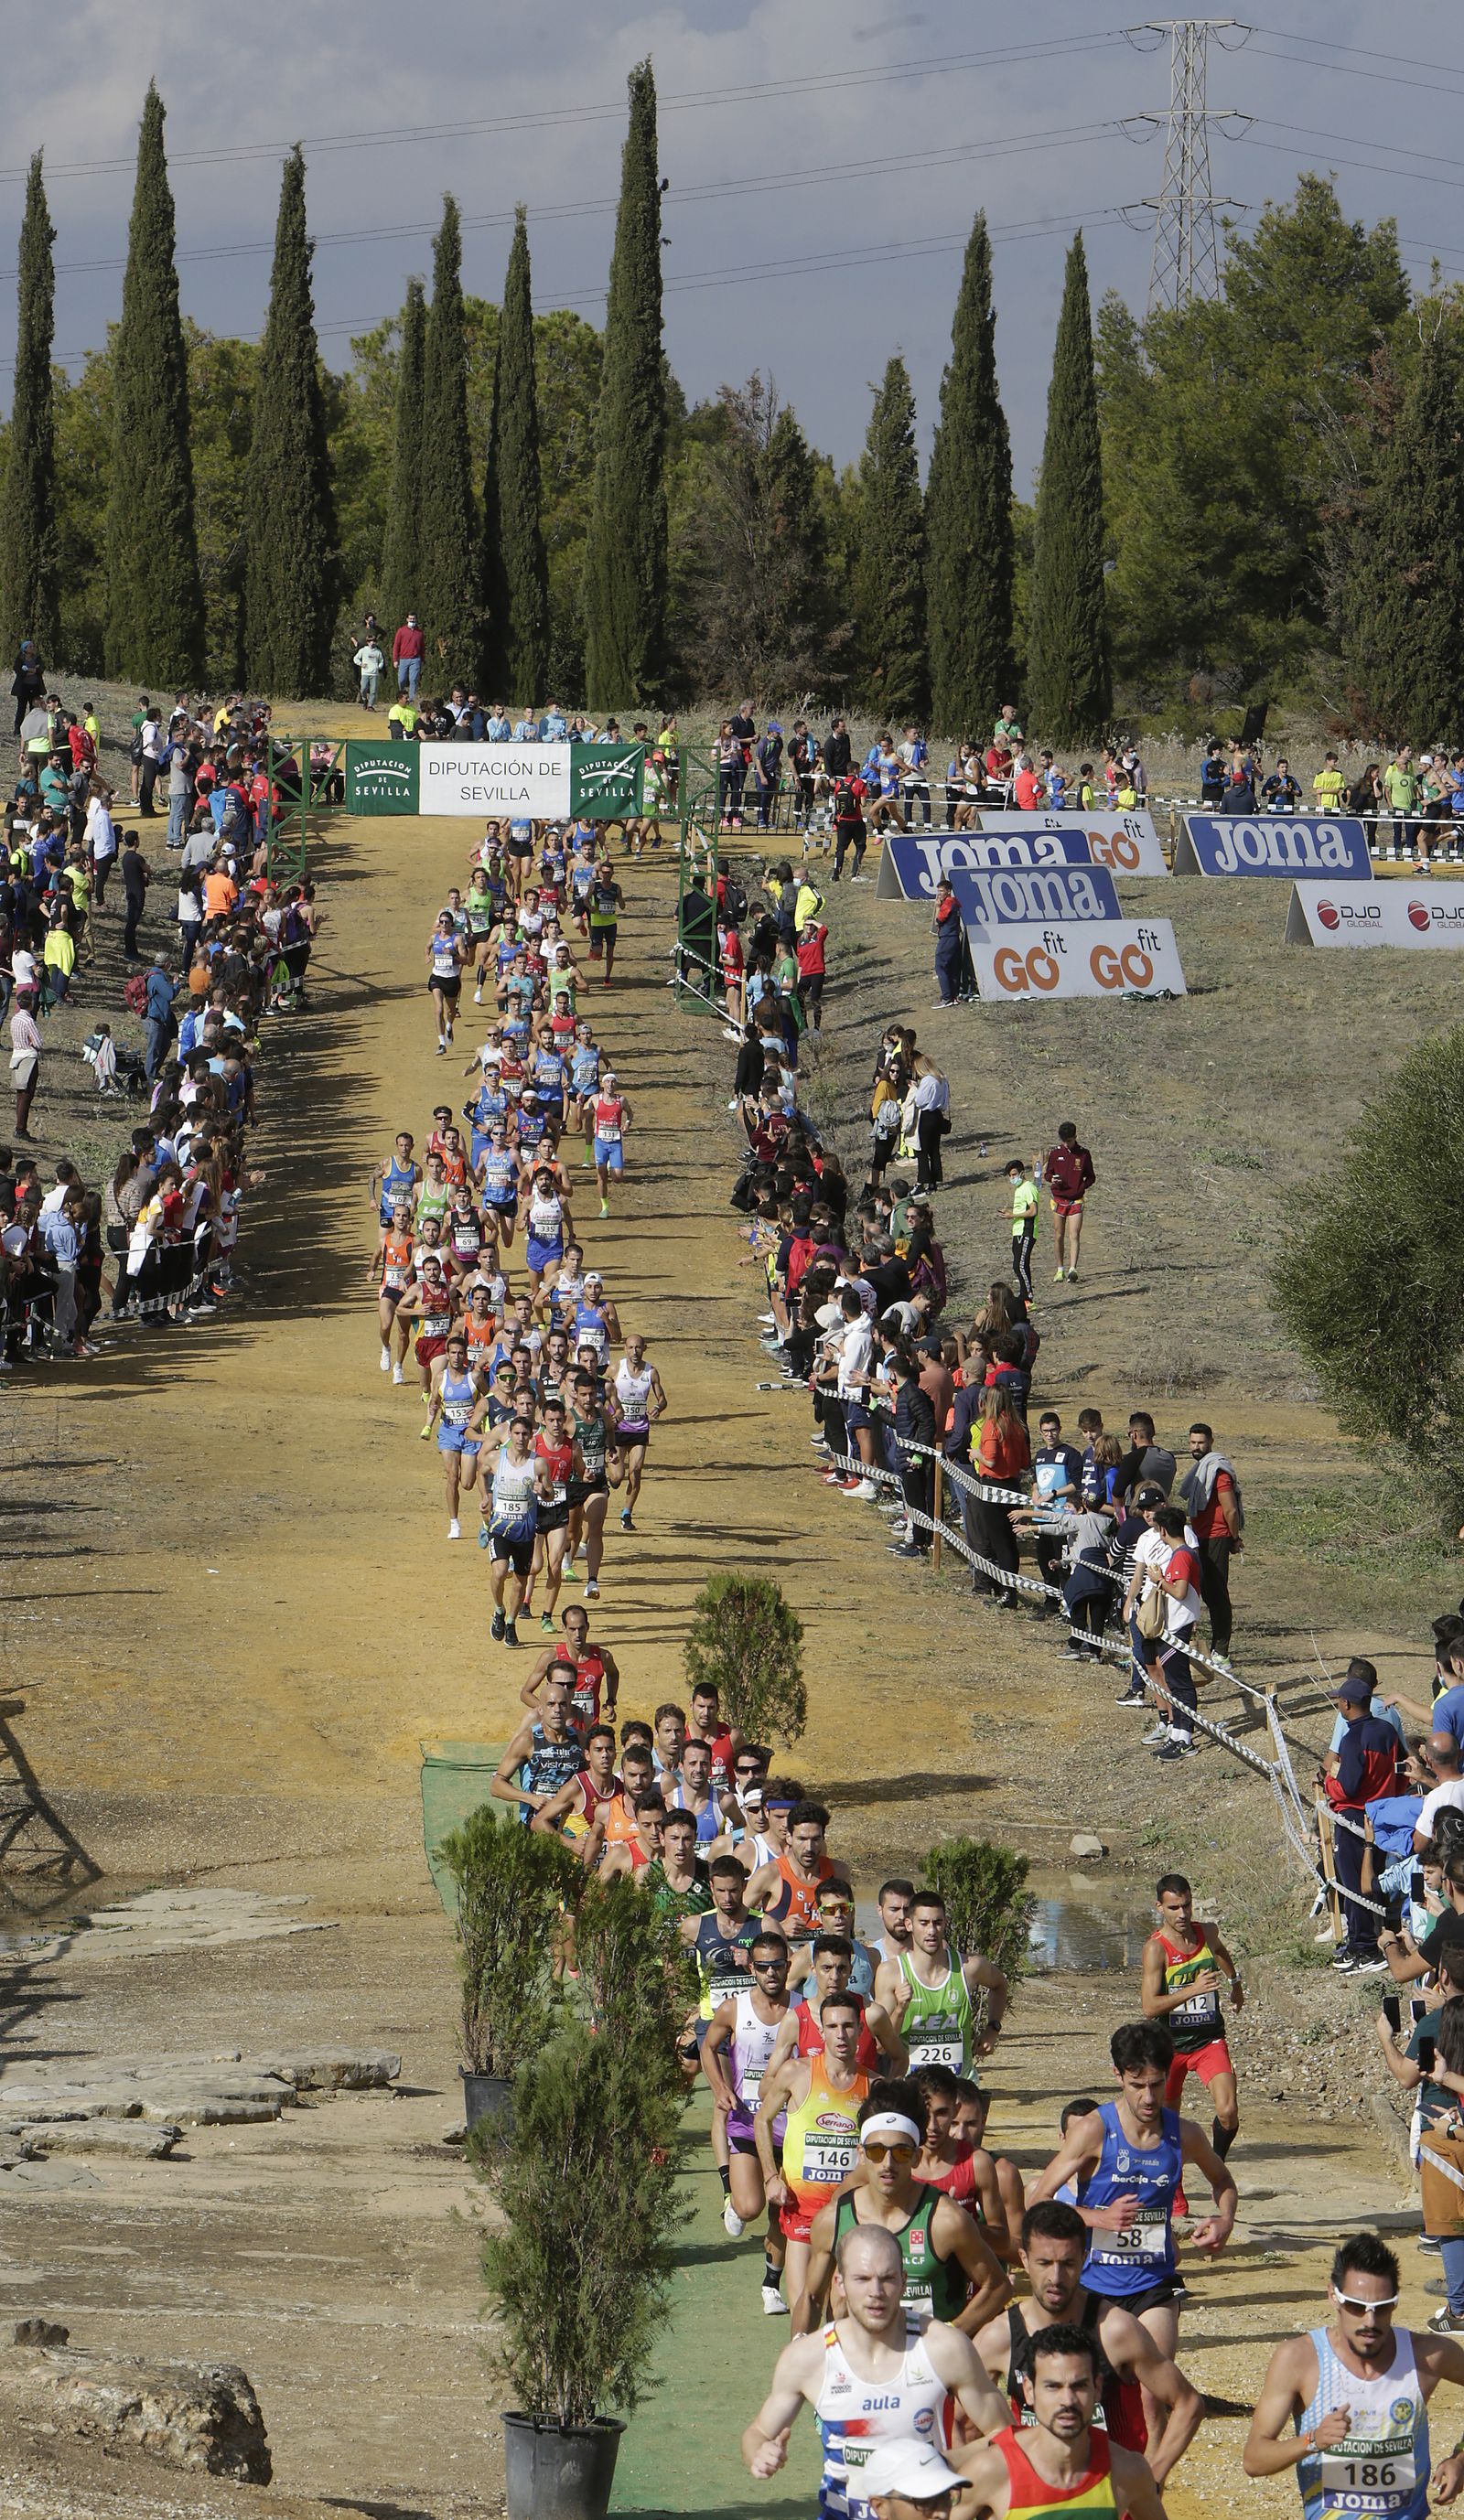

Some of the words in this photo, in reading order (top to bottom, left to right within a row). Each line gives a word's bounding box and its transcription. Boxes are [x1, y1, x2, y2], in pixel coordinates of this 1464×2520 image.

[353, 759, 412, 774] DIPUTACION
[429, 759, 533, 776] DIPUTACIÓN
[540, 762, 562, 776] DE
[578, 760, 637, 775] DIPUTACON
[355, 786, 411, 797] SEVILLA
[460, 787, 531, 800] SEVILLA
[580, 787, 635, 798] SEVILLA
[1124, 819, 1145, 839] fit
[1340, 906, 1382, 919] DJO
[1347, 920, 1383, 928] GLOBAL
[993, 947, 1060, 993] GO
[1043, 930, 1068, 954] fit
[1090, 943, 1154, 989] GO
[1137, 928, 1162, 951] fit
[625, 1406, 640, 1414] 350
[503, 1503, 521, 1512] 185
[1184, 1997, 1207, 2011] 112
[921, 2048, 952, 2062] 226
[818, 2151, 850, 2167] 146
[1116, 2229, 1142, 2247] 58
[862, 2396, 900, 2411] aula
[1373, 2444, 1383, 2453] DE
[1383, 2440, 1413, 2453] SEVILLA
[1344, 2462, 1396, 2487] 186
